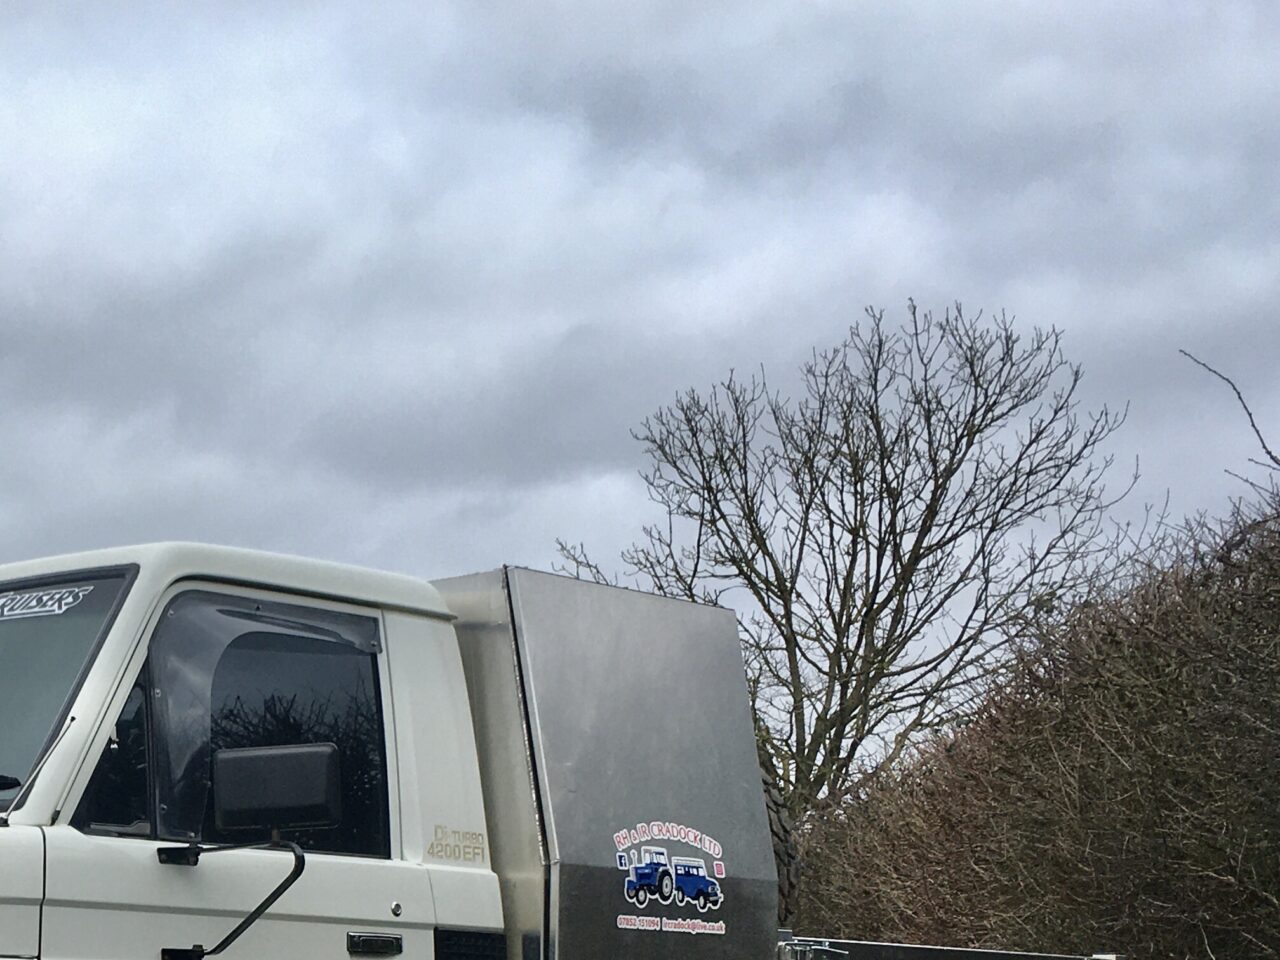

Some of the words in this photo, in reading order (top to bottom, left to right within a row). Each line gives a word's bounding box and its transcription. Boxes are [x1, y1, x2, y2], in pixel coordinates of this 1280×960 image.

[615, 830, 629, 849] RH
[631, 831, 638, 842] &
[637, 824, 649, 840] IR
[651, 823, 700, 846] CRADOCK
[702, 835, 721, 857] LTD
